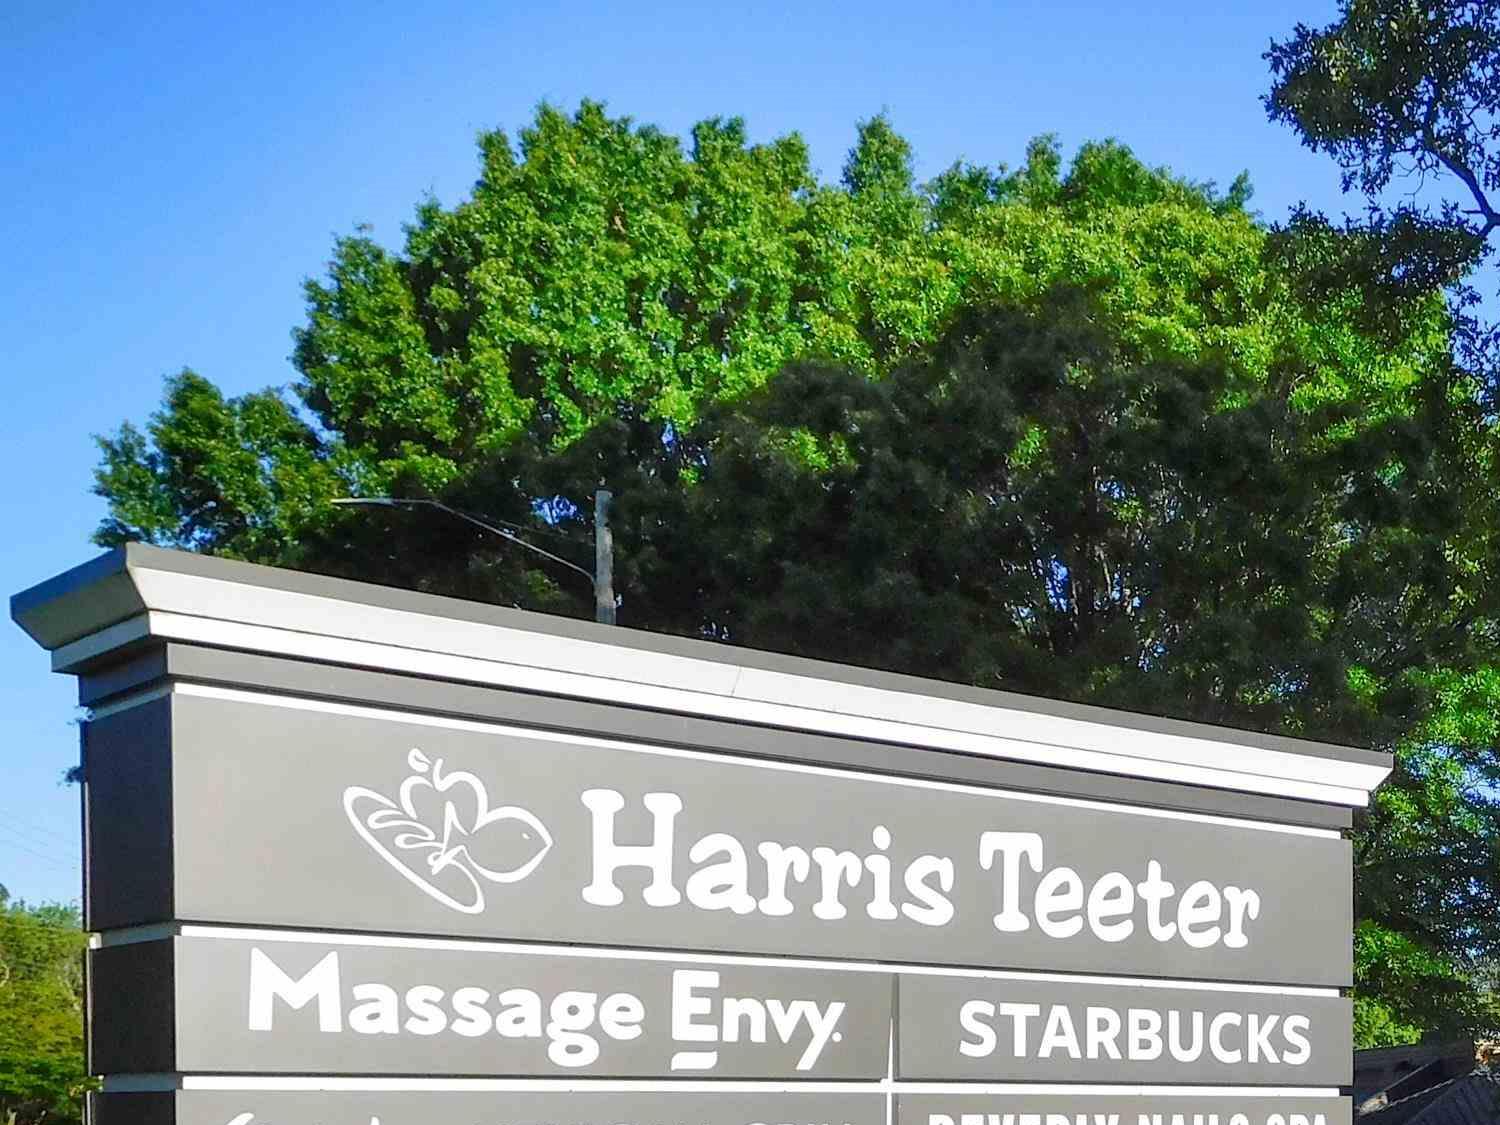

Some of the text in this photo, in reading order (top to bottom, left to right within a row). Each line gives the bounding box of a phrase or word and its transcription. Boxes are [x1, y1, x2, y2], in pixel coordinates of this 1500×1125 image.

[581, 788, 1261, 949] Harris Teeter
[248, 946, 645, 1068] Massage
[959, 1000, 1311, 1065] STARBUCKS
